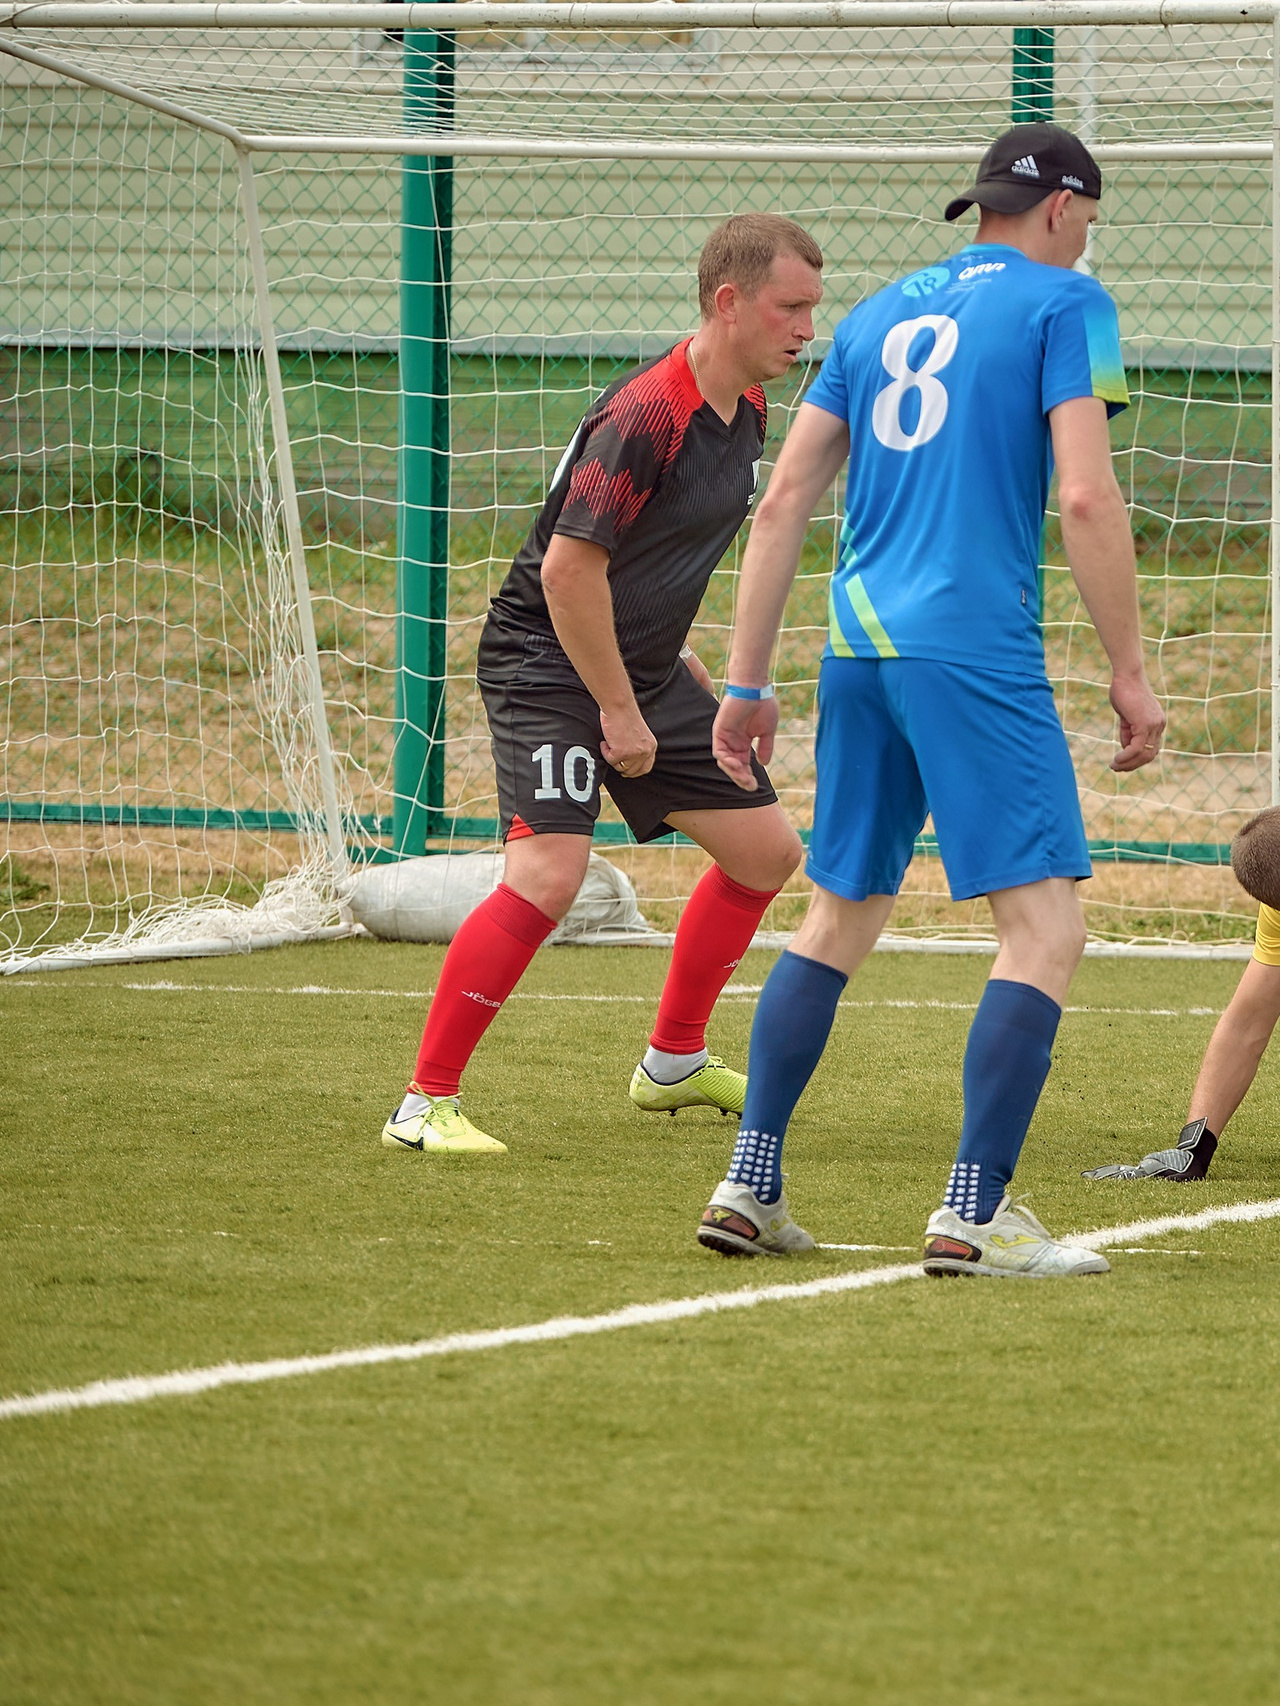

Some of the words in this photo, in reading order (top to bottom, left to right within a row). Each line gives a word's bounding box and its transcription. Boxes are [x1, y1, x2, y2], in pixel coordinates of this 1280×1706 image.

[1011, 165, 1040, 177] adidas
[1061, 175, 1084, 189] adidas
[873, 315, 959, 451] 8
[532, 744, 595, 802] 10
